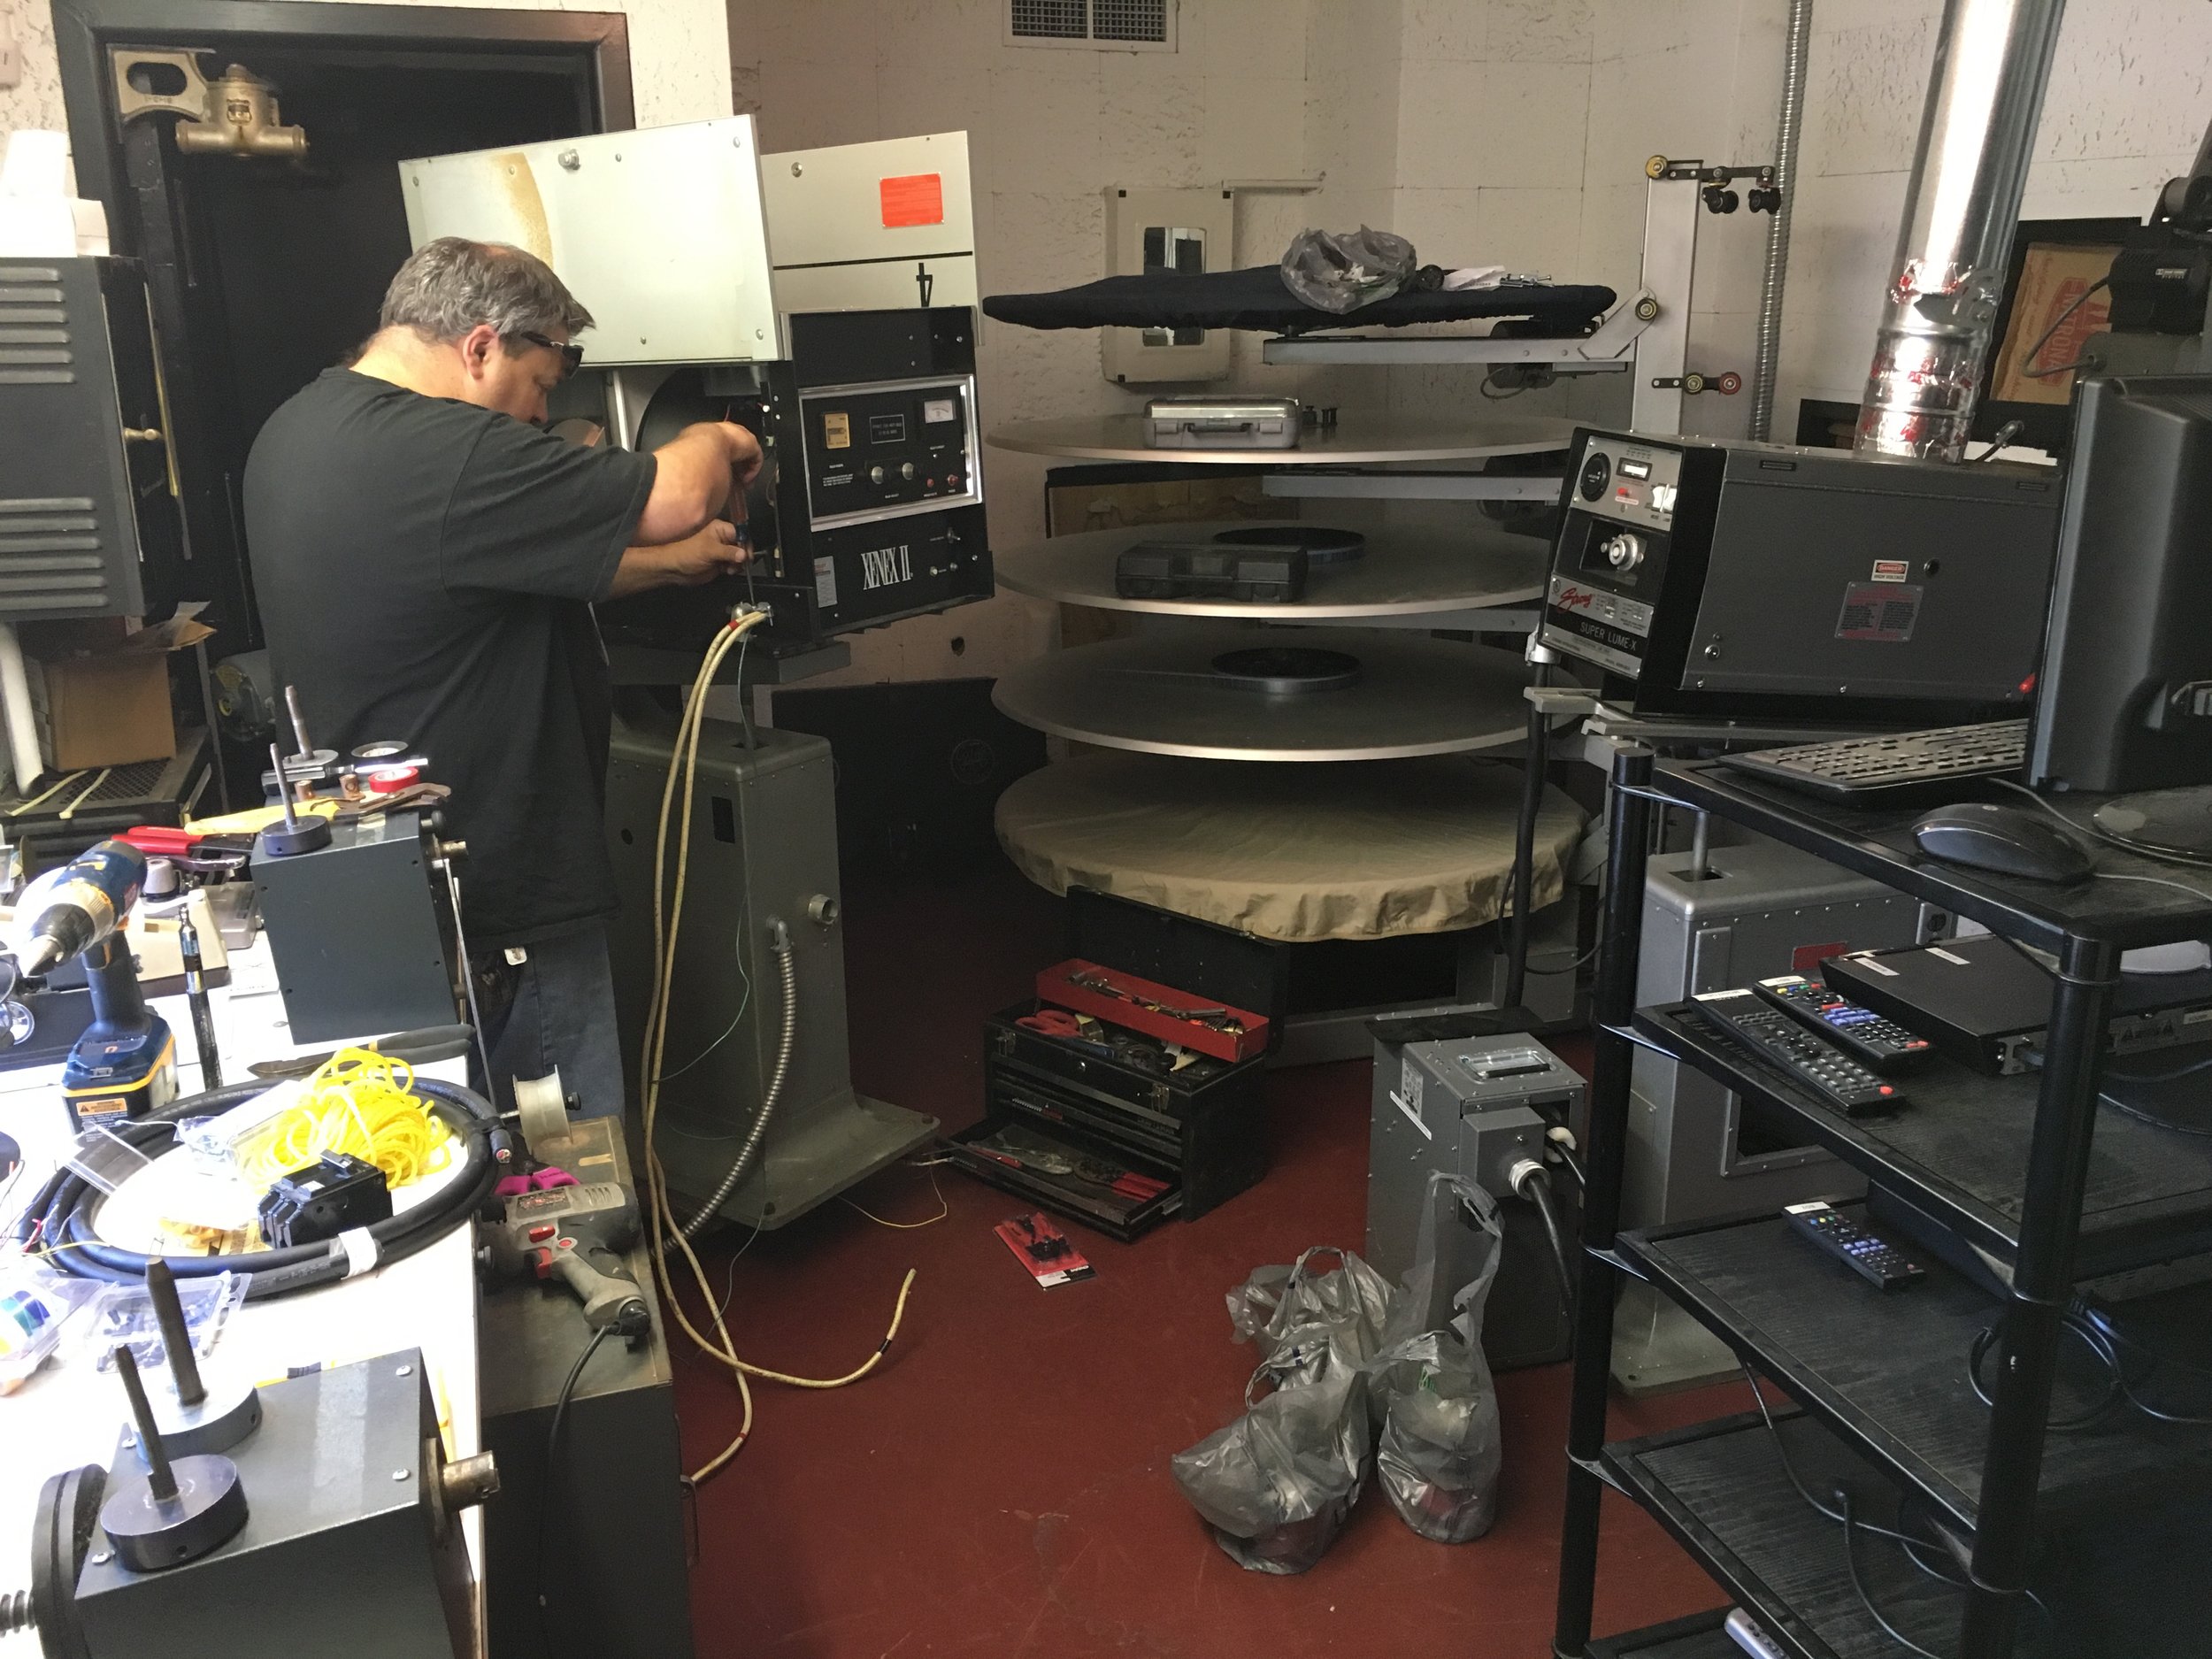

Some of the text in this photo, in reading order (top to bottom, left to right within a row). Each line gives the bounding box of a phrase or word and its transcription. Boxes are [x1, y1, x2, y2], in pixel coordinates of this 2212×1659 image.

[2045, 293, 2080, 370] NTRONA
[861, 547, 900, 590] XENEX
[899, 545, 911, 581] II
[1579, 621, 1605, 640] SUPER
[1608, 631, 1637, 651] LUME-X
